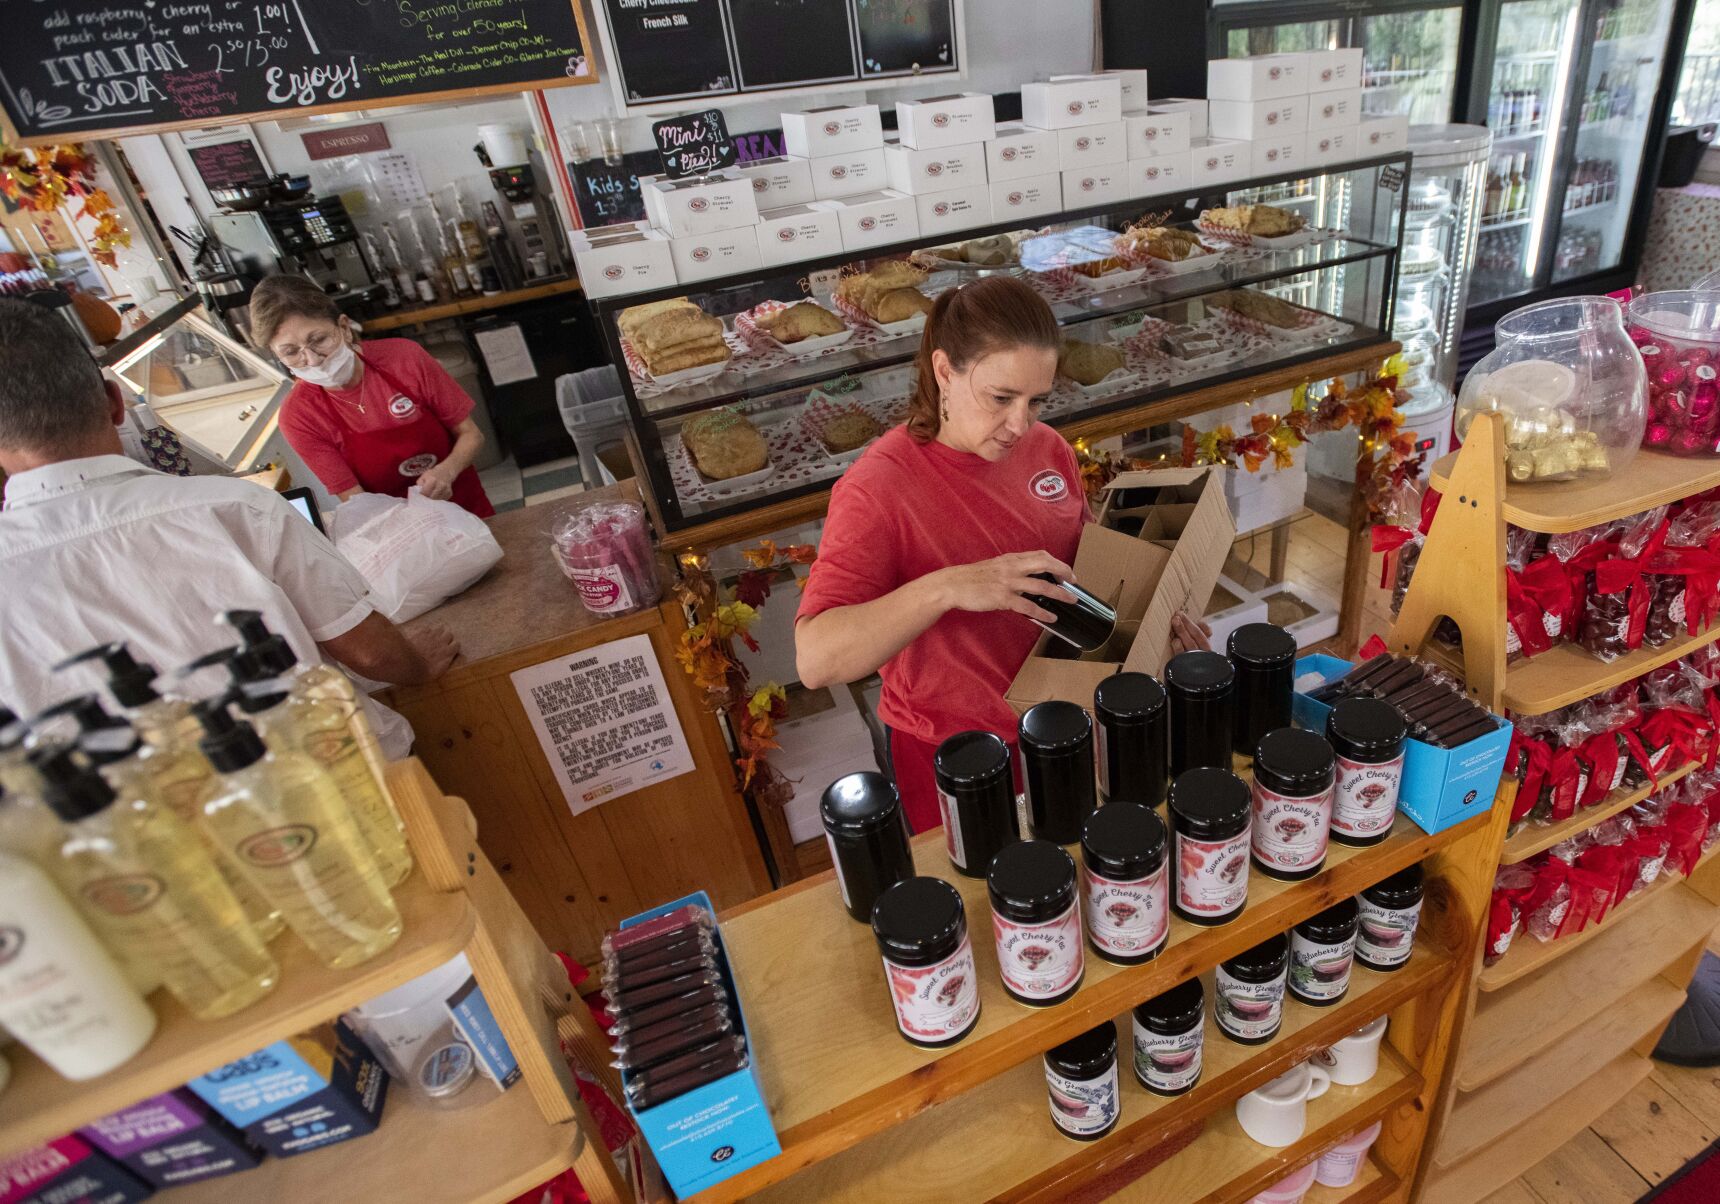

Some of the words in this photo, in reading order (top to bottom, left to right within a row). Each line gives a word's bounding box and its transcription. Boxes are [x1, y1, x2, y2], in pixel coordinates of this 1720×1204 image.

[44, 10, 70, 28] add
[162, 3, 212, 27] cherry
[225, 1, 241, 11] or
[398, 1, 459, 27] Serving
[643, 16, 672, 29] French
[672, 14, 689, 26] Silk
[53, 32, 96, 50] peach
[102, 27, 139, 42] cider
[150, 25, 171, 42] for
[183, 24, 200, 35] an
[208, 21, 244, 33] extra
[427, 25, 444, 41] for
[452, 27, 471, 37] over
[473, 19, 495, 34] 50
[40, 41, 188, 87] ITALIAN
[266, 55, 361, 106] Enjoy!
[77, 76, 167, 112] SODA
[703, 112, 719, 124] $10
[320, 134, 369, 149] ESPRESSO
[659, 120, 706, 148] Mini
[707, 131, 724, 143] $11
[587, 174, 624, 196] Kids
[586, 584, 614, 593] CANDY
[569, 656, 599, 672] WARNING
[543, 681, 563, 691] ILLEGAL
[1343, 773, 1364, 793] Sweet
[1366, 770, 1392, 781] Cherry
[1263, 805, 1281, 823] Sweet
[1283, 804, 1312, 817] Cherry
[1205, 852, 1226, 875] Sweet
[1093, 889, 1109, 907] Sweet
[1111, 888, 1143, 901] Cherry
[1142, 894, 1153, 910] Tea
[1004, 935, 1019, 952] Sweet
[1021, 932, 1054, 943] Cherry
[1055, 936, 1066, 951] Tea
[919, 977, 940, 1000] Sweet
[940, 959, 966, 977] Cherry
[234, 1098, 261, 1111] LIP
[262, 1083, 309, 1103] BALM
[1064, 1080, 1090, 1094] Green
[667, 1121, 682, 1131] OUT
[683, 1115, 694, 1123] OF
